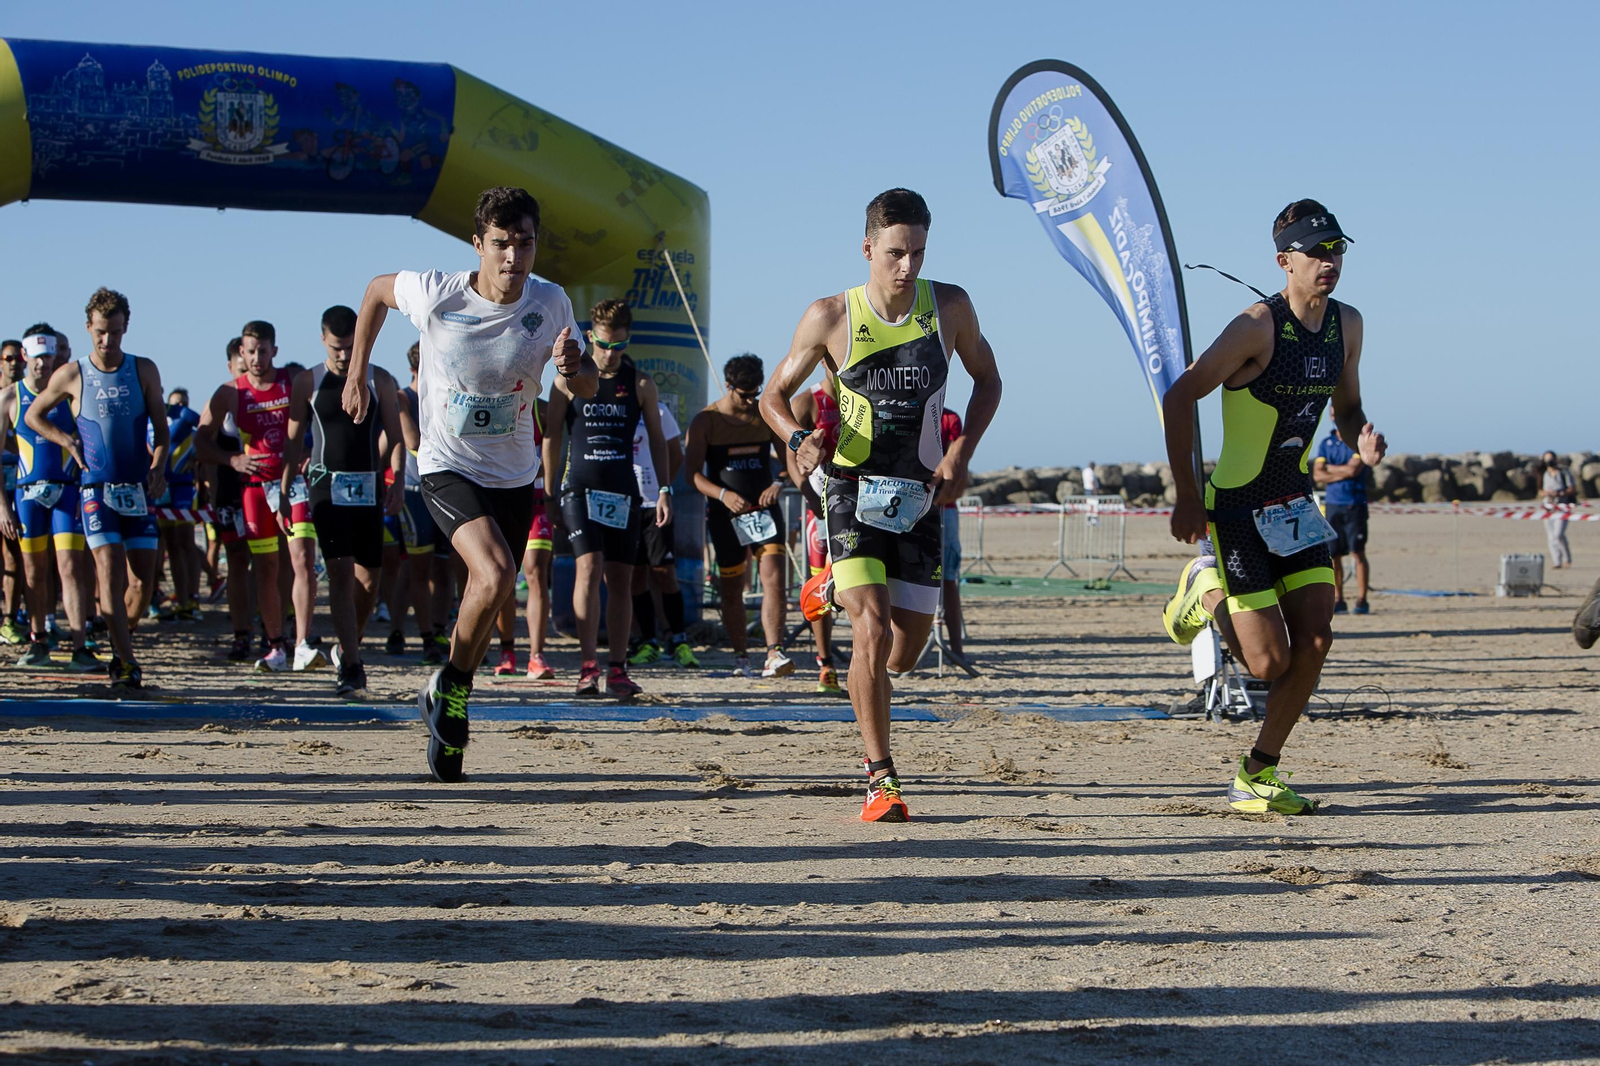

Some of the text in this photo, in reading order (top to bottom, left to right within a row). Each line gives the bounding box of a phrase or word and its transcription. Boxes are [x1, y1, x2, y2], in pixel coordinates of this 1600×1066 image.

[177, 62, 298, 88] POLIDEPORTIVO OLIMPO
[1304, 356, 1326, 378] VELA
[866, 365, 931, 391] MONTERO
[95, 385, 130, 401] ADS
[98, 402, 130, 418] BASTOS
[474, 409, 491, 428] 9
[583, 403, 627, 417] CORONIL
[853, 403, 867, 430] RECOVER
[344, 483, 365, 498] 14
[115, 494, 136, 509] 15
[596, 502, 621, 519] 12
[883, 496, 902, 519] 8
[746, 522, 763, 535] 16
[1285, 517, 1299, 540] 7
